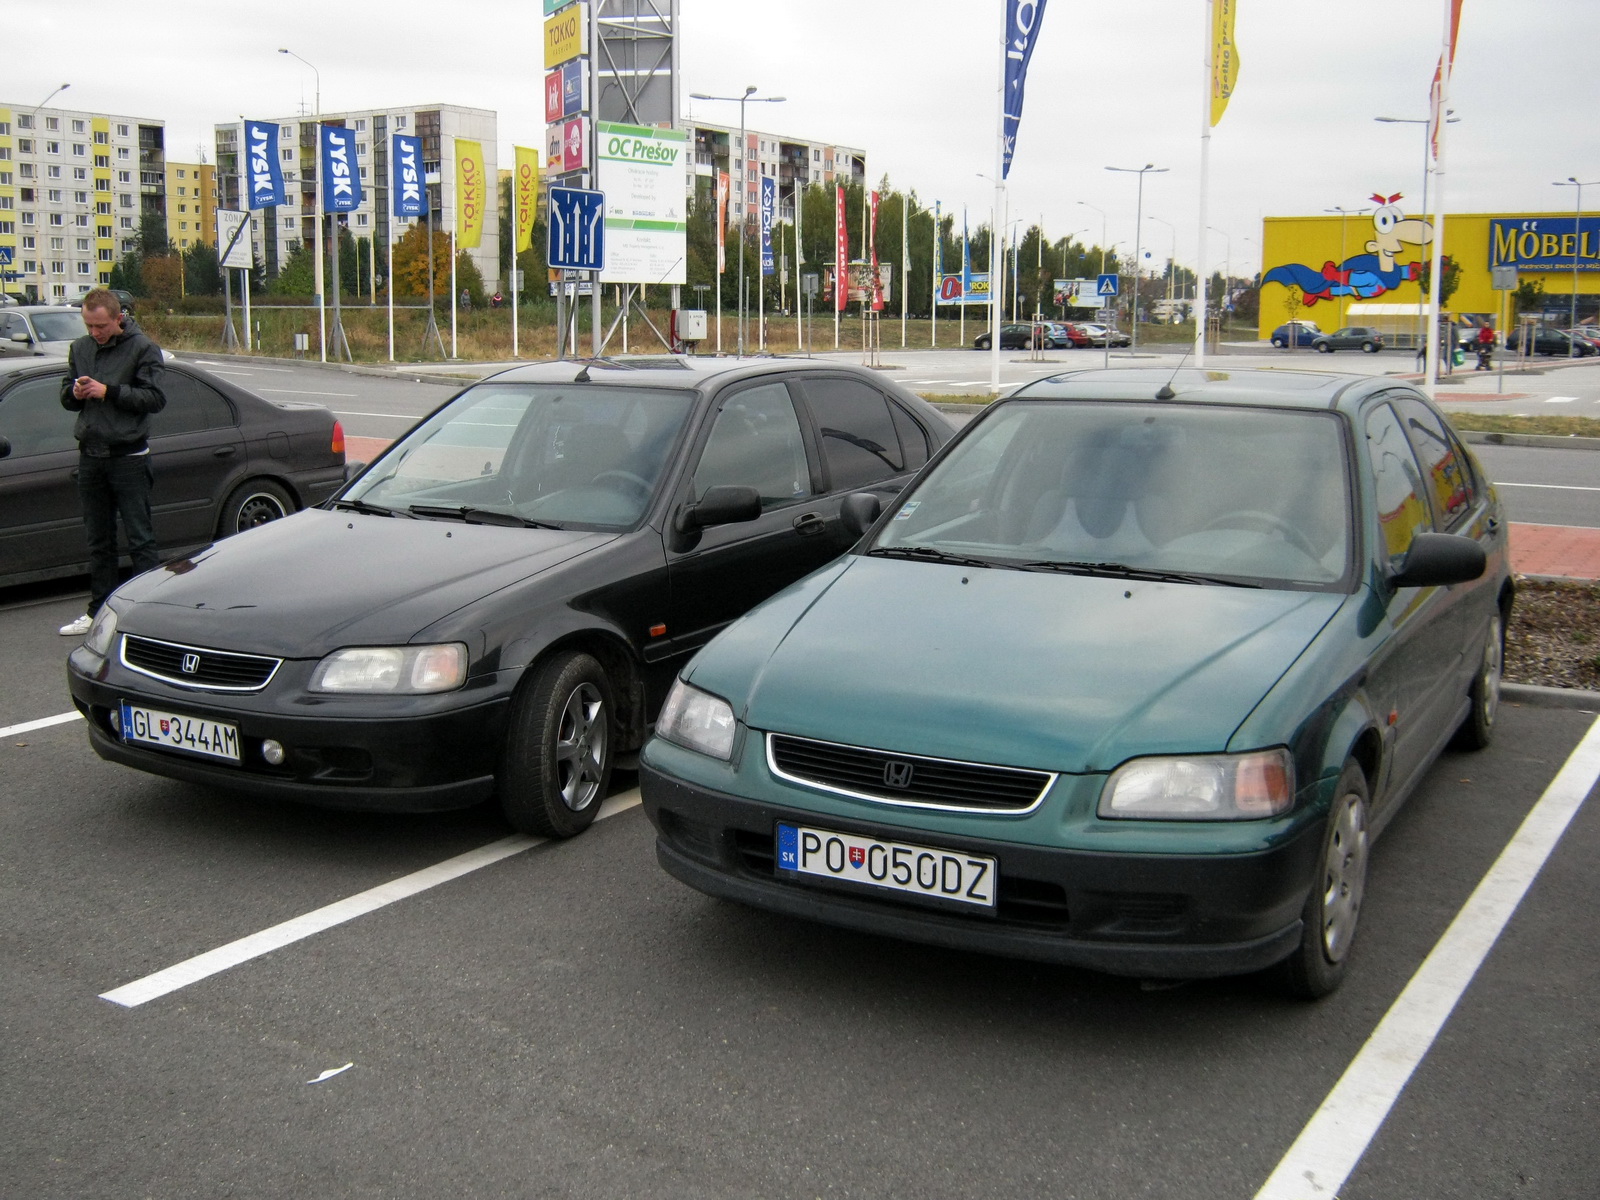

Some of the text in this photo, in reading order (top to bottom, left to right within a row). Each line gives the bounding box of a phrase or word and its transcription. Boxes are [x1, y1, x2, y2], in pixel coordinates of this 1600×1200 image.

[251, 126, 274, 193] JYSK
[329, 132, 353, 196] JYSK
[400, 139, 420, 201] JYSK
[608, 137, 679, 161] OC Prešov
[1492, 222, 1600, 267] MÖBEL
[133, 710, 238, 756] GL 344AM
[782, 851, 795, 863] SK
[802, 832, 988, 900] PO 050DZ
